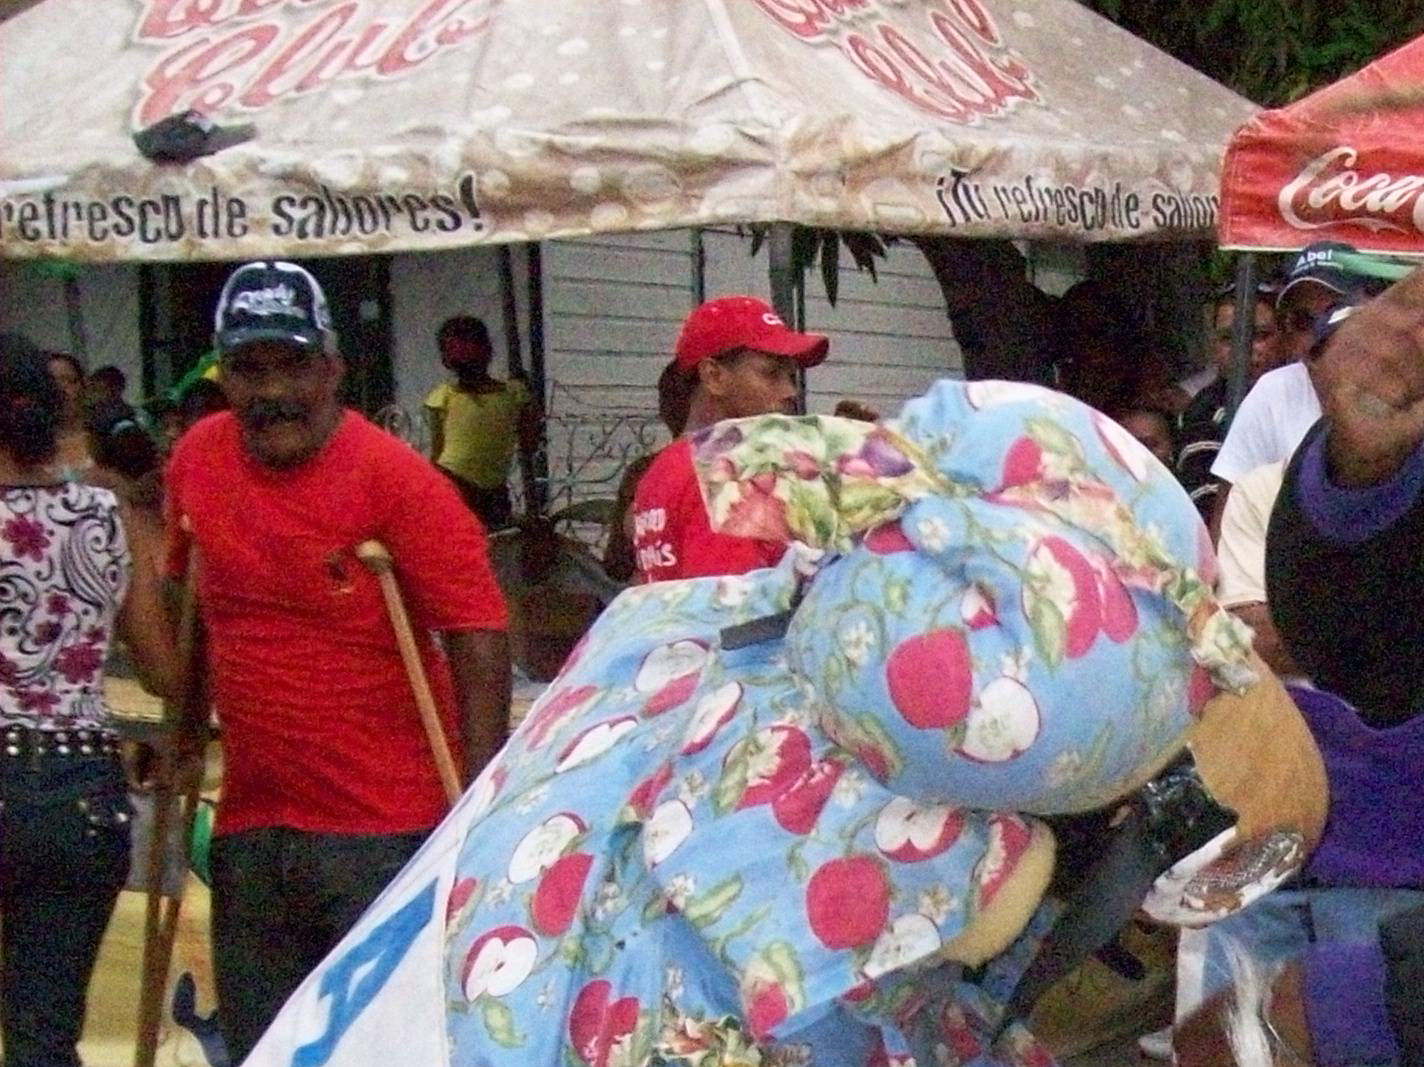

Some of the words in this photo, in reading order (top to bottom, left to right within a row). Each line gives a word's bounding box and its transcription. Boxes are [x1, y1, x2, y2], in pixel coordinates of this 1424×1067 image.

[197, 186, 250, 239] de
[271, 174, 484, 240] sabores!
[993, 175, 1106, 231] refresco
[1111, 182, 1141, 229] de
